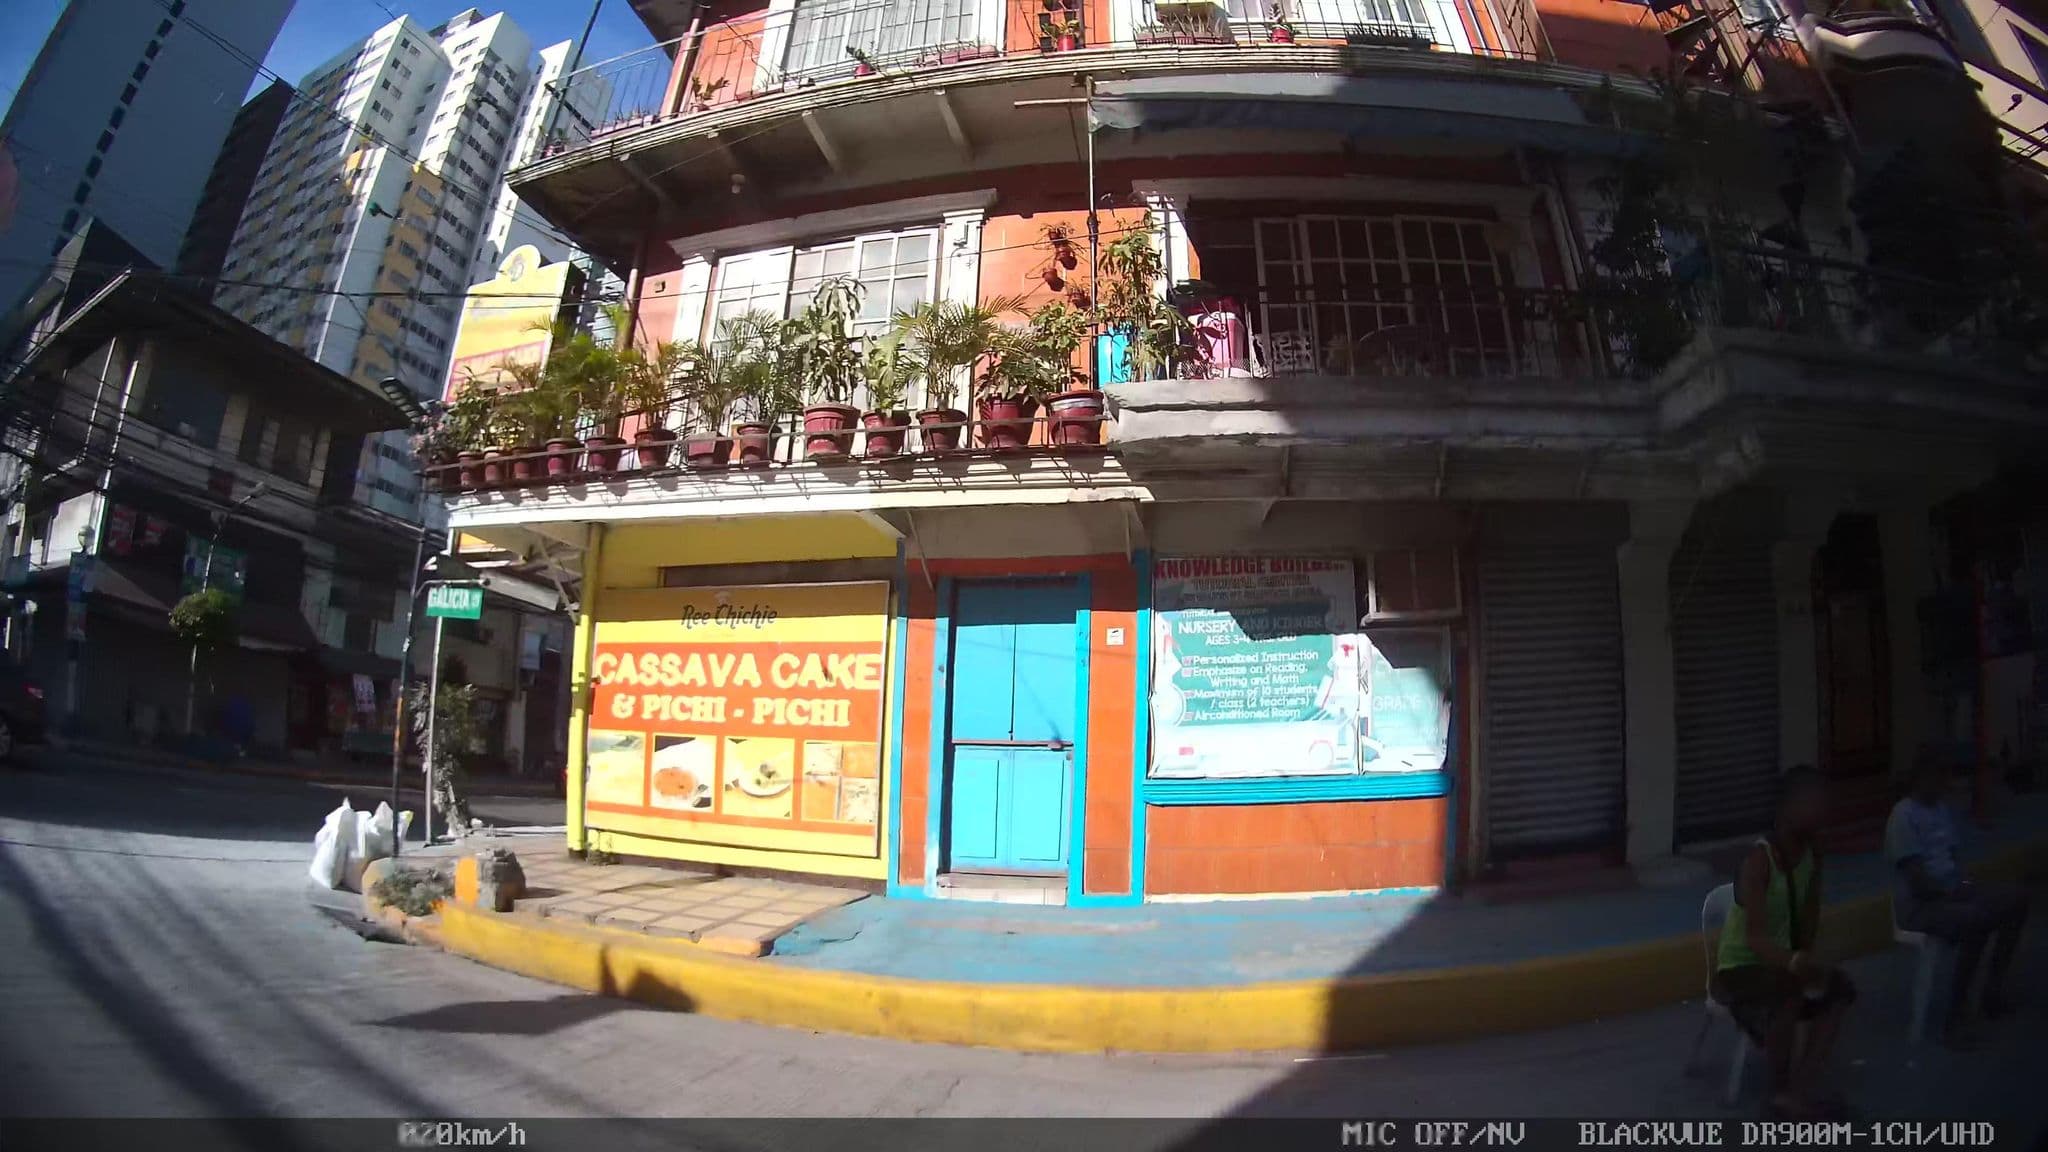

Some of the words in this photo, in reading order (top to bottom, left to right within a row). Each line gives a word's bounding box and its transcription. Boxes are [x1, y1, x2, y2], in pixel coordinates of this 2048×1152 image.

[1154, 558, 1266, 578] KNOWLEDGE
[428, 587, 469, 609] GALICIA
[681, 604, 711, 629] Ree
[715, 603, 778, 629] Chichie
[1178, 620, 1237, 635] NURSERY
[1205, 634, 1231, 646] AGES
[1193, 652, 1259, 665] Personalized
[1262, 650, 1319, 662] Instruction
[594, 652, 762, 688] CASSAVA
[770, 653, 882, 690] CAKE
[1193, 665, 1247, 678] Emphasize
[1250, 667, 1263, 675] on
[1211, 676, 1247, 689] Writing
[1250, 675, 1269, 685] and
[1272, 674, 1300, 684] Math
[1194, 688, 1244, 698] Maximum
[1247, 687, 1258, 698] of
[1262, 686, 1272, 696] 10
[1274, 683, 1318, 695] students
[1218, 698, 1244, 708] class
[1260, 695, 1310, 708] teachers)
[611, 693, 637, 719] &
[641, 694, 727, 723] PICHI
[752, 697, 851, 727] PICHI
[1195, 708, 1268, 721] Airconditioned
[1272, 708, 1301, 718] Room
